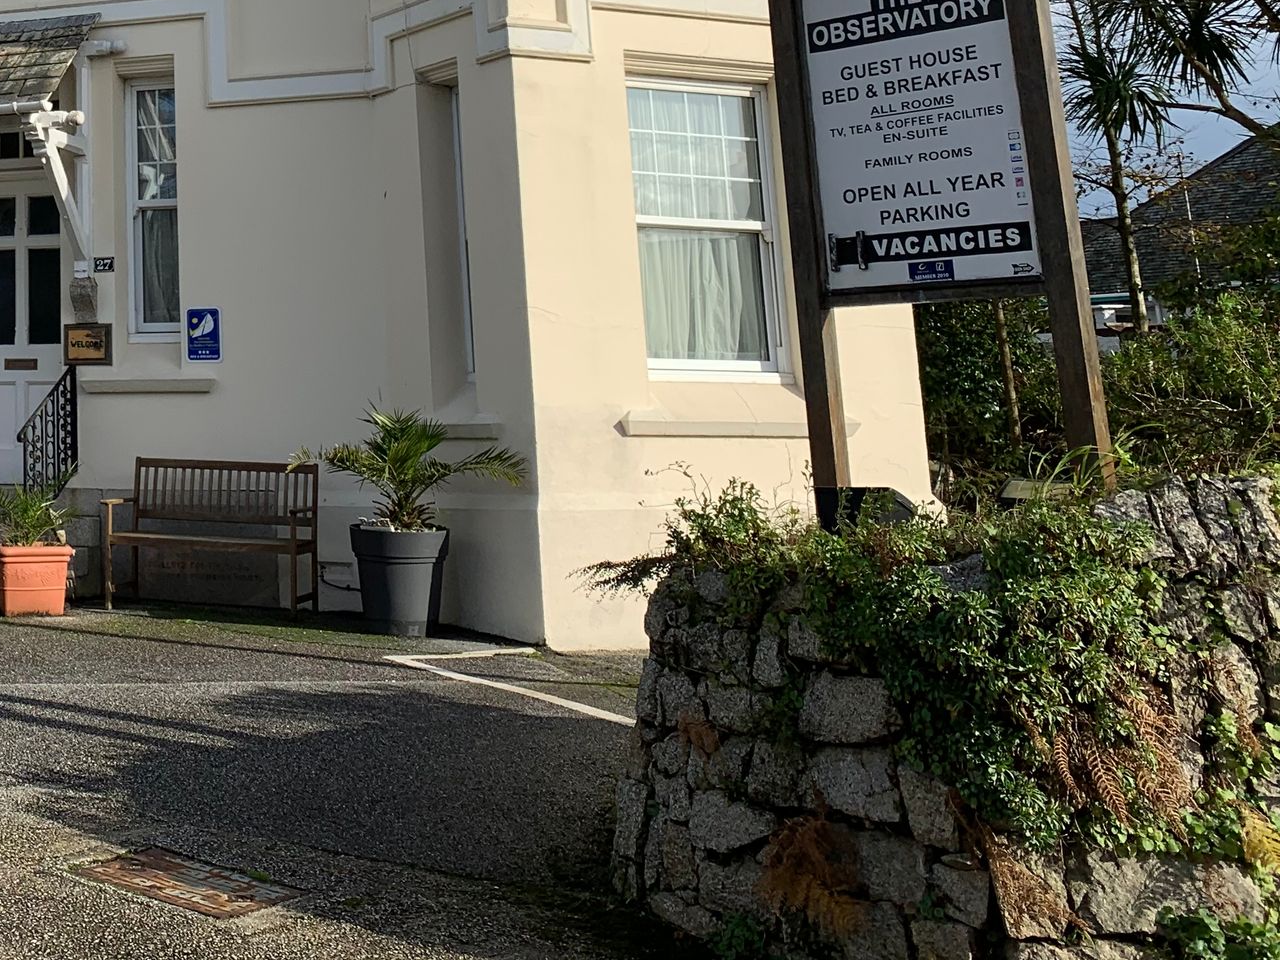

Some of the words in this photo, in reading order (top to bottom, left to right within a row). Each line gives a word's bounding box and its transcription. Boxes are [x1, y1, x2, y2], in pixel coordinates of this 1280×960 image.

[840, 57, 903, 81] GUEST
[908, 44, 978, 70] HOUSE
[822, 86, 860, 105] BED
[865, 83, 879, 99] &
[883, 63, 1002, 96] BREAKFAST
[870, 103, 897, 116] ALL
[901, 94, 955, 111] ROOMS
[829, 127, 847, 138] TV,
[849, 124, 872, 136] TEA
[875, 121, 884, 132] &
[886, 114, 934, 130] COFFEE
[937, 104, 1005, 123] FACILITIES
[883, 126, 949, 144] EN-SUITE
[864, 154, 914, 169] FAMILY
[918, 146, 973, 162] ROOMS
[842, 184, 897, 205] OPEN
[902, 179, 942, 198] ALL
[946, 172, 1006, 193] YEAR
[879, 201, 971, 226] PARKING
[872, 228, 1021, 257] VACANCIES
[96, 259, 112, 270] 27
[70, 340, 105, 349] WELCOME
